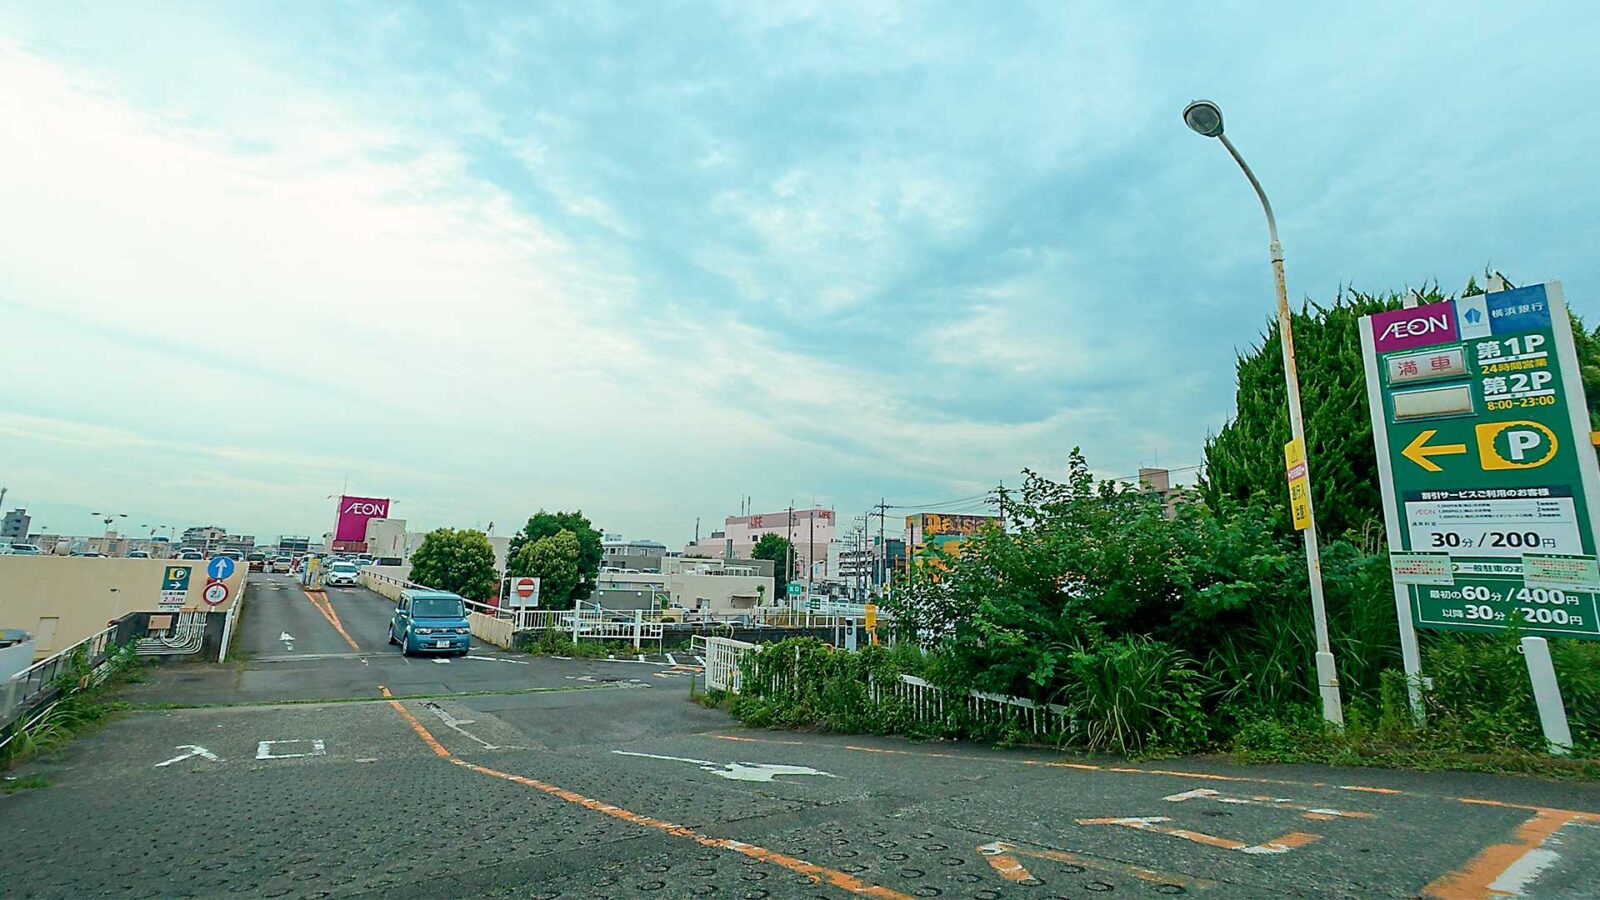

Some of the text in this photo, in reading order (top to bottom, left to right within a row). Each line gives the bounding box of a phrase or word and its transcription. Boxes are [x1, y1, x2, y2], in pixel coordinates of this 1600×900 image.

[1491, 302, 1544, 318] 横浜銀行
[1481, 359, 1547, 374] 24時間営業
[1421, 487, 1550, 500] 割引サービスご利用のお客様
